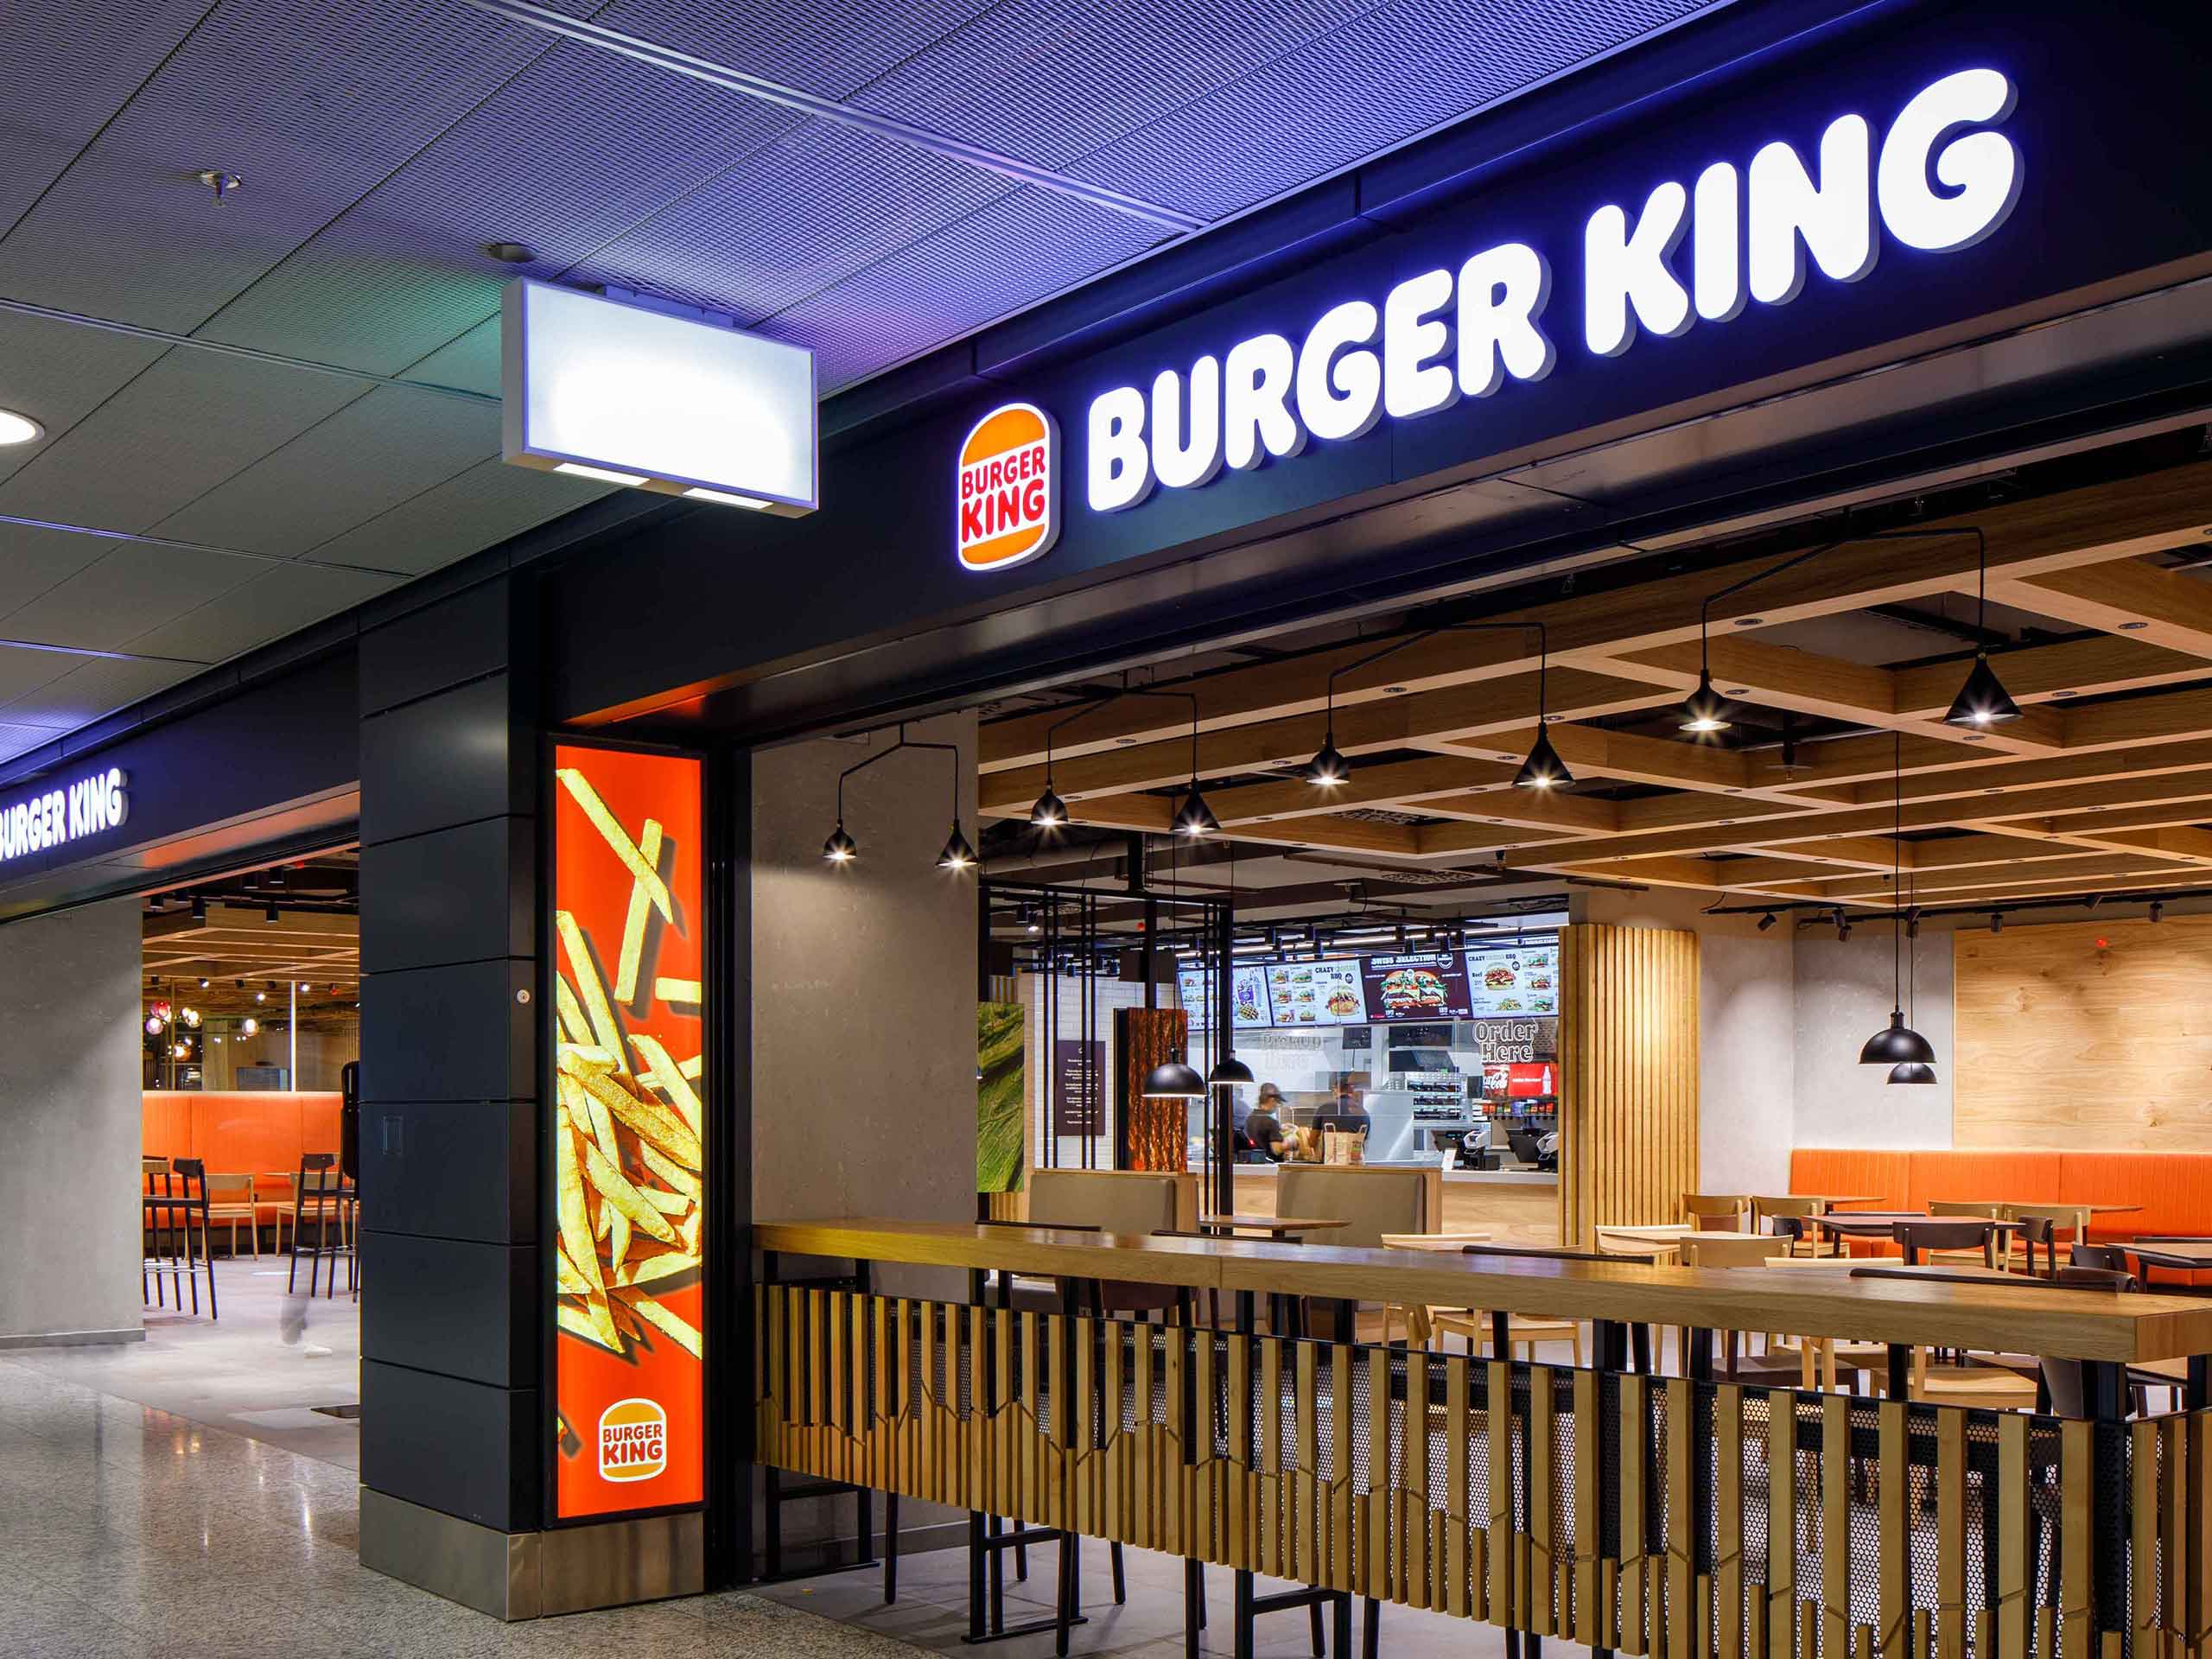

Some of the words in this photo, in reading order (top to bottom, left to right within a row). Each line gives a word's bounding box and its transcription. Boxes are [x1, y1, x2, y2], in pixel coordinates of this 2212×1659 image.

[1088, 243, 1550, 513] BURGER
[1585, 68, 2018, 356] KING
[962, 446, 1046, 500] BURGER
[962, 478, 1046, 543] KING
[69, 767, 124, 840] KING
[1473, 1020, 1539, 1044] Order
[1479, 1041, 1535, 1064] Here
[602, 1424, 663, 1444] BURGER
[602, 1440, 664, 1466] KING
